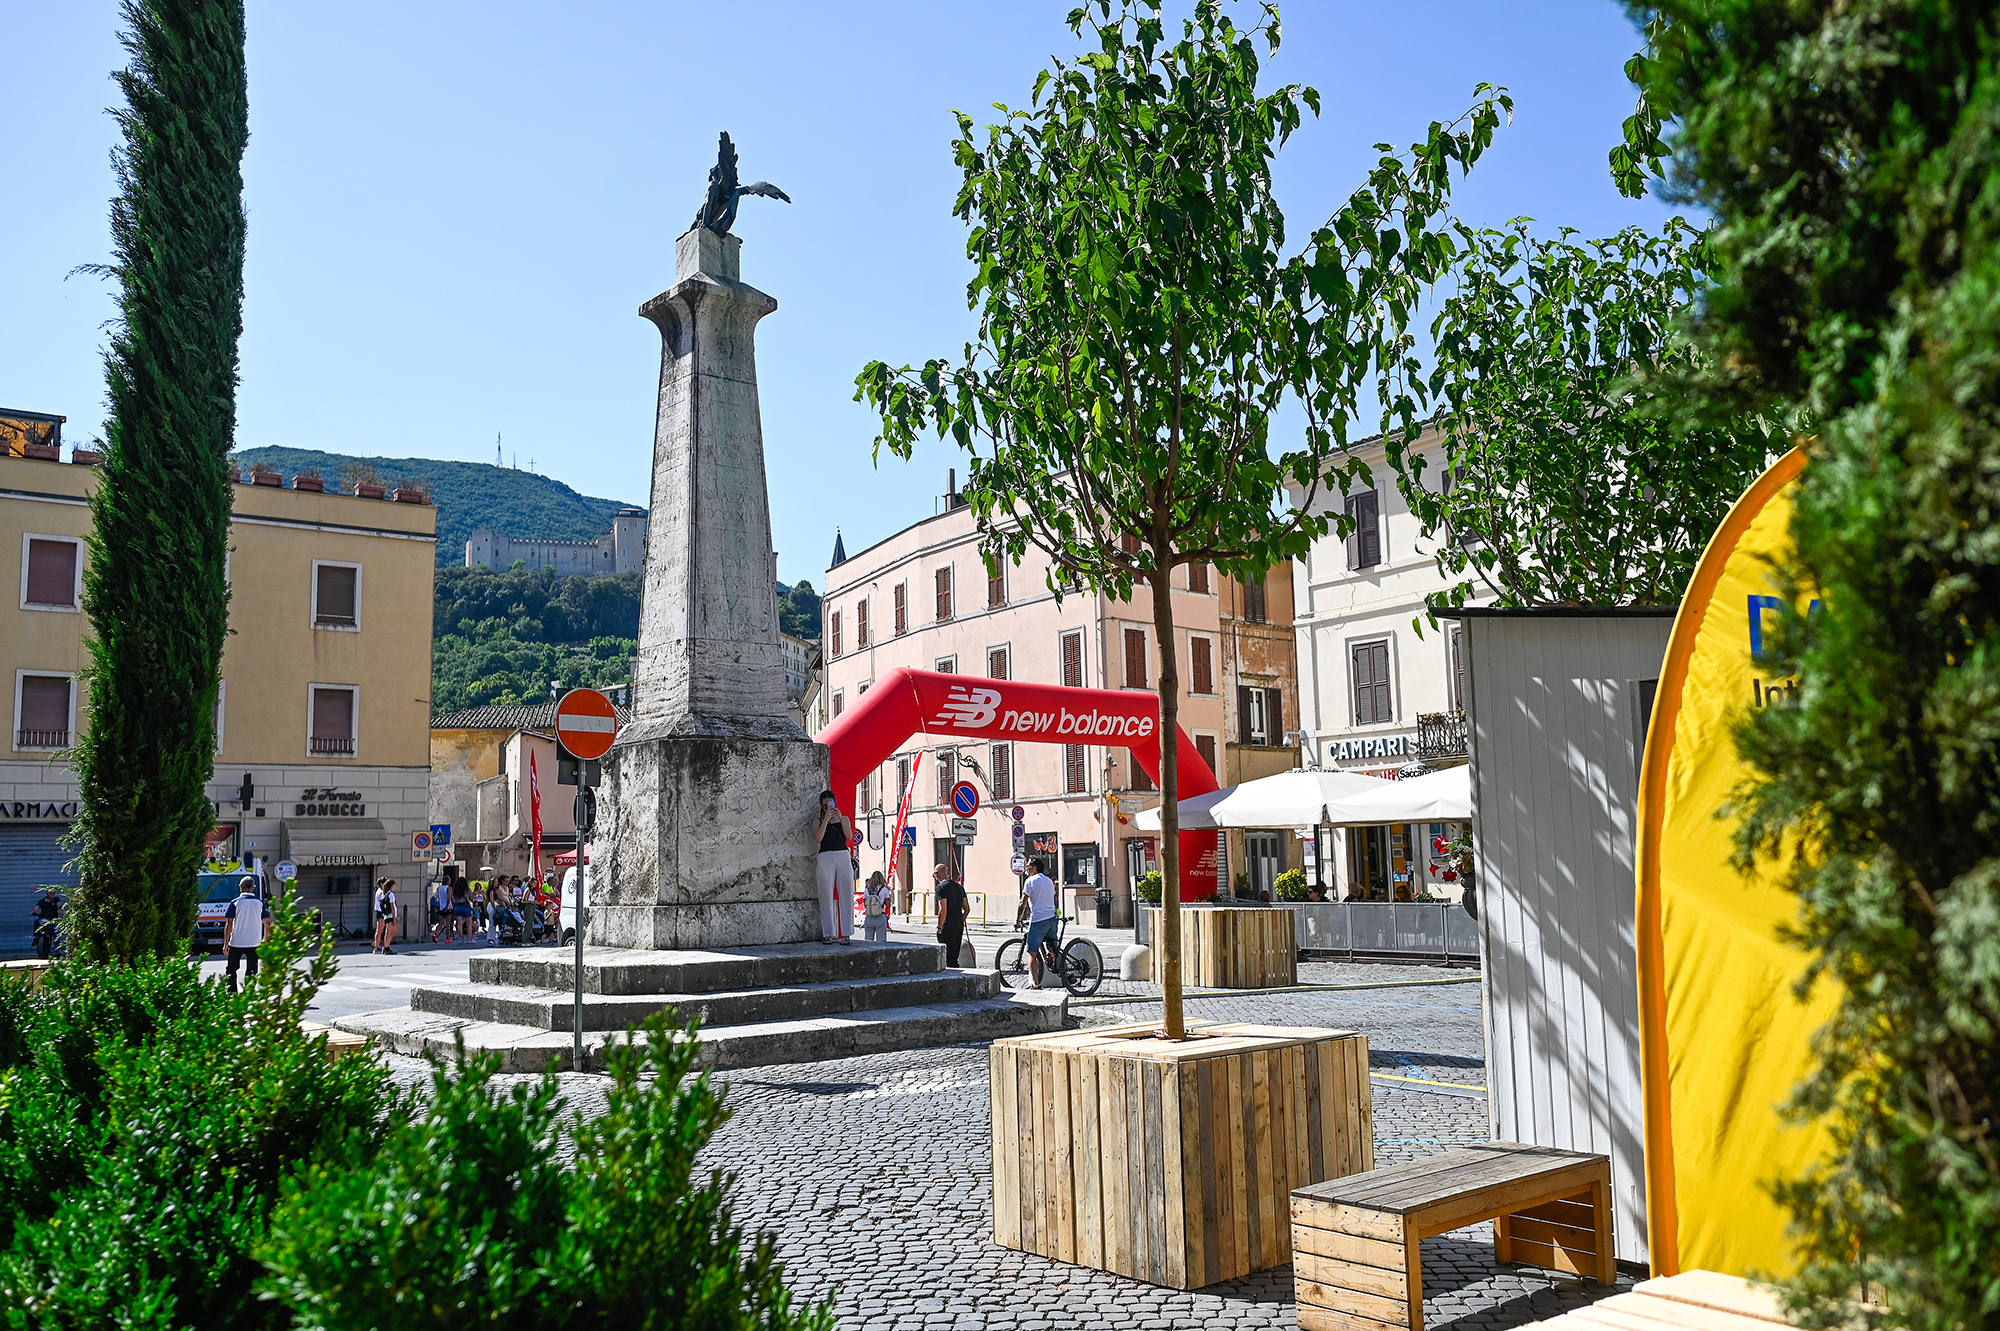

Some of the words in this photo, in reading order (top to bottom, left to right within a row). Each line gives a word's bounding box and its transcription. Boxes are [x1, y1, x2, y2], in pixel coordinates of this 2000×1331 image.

[999, 709, 1056, 733] new
[1055, 707, 1154, 737] balance
[1328, 736, 1406, 760] CAMPARI
[302, 788, 318, 801] Il
[318, 787, 362, 801] Fornaio
[0, 802, 78, 818] ARMACI
[295, 803, 366, 817] BONUCCI
[314, 855, 366, 864] CAFFETTERIA
[1205, 869, 1218, 877] bala
